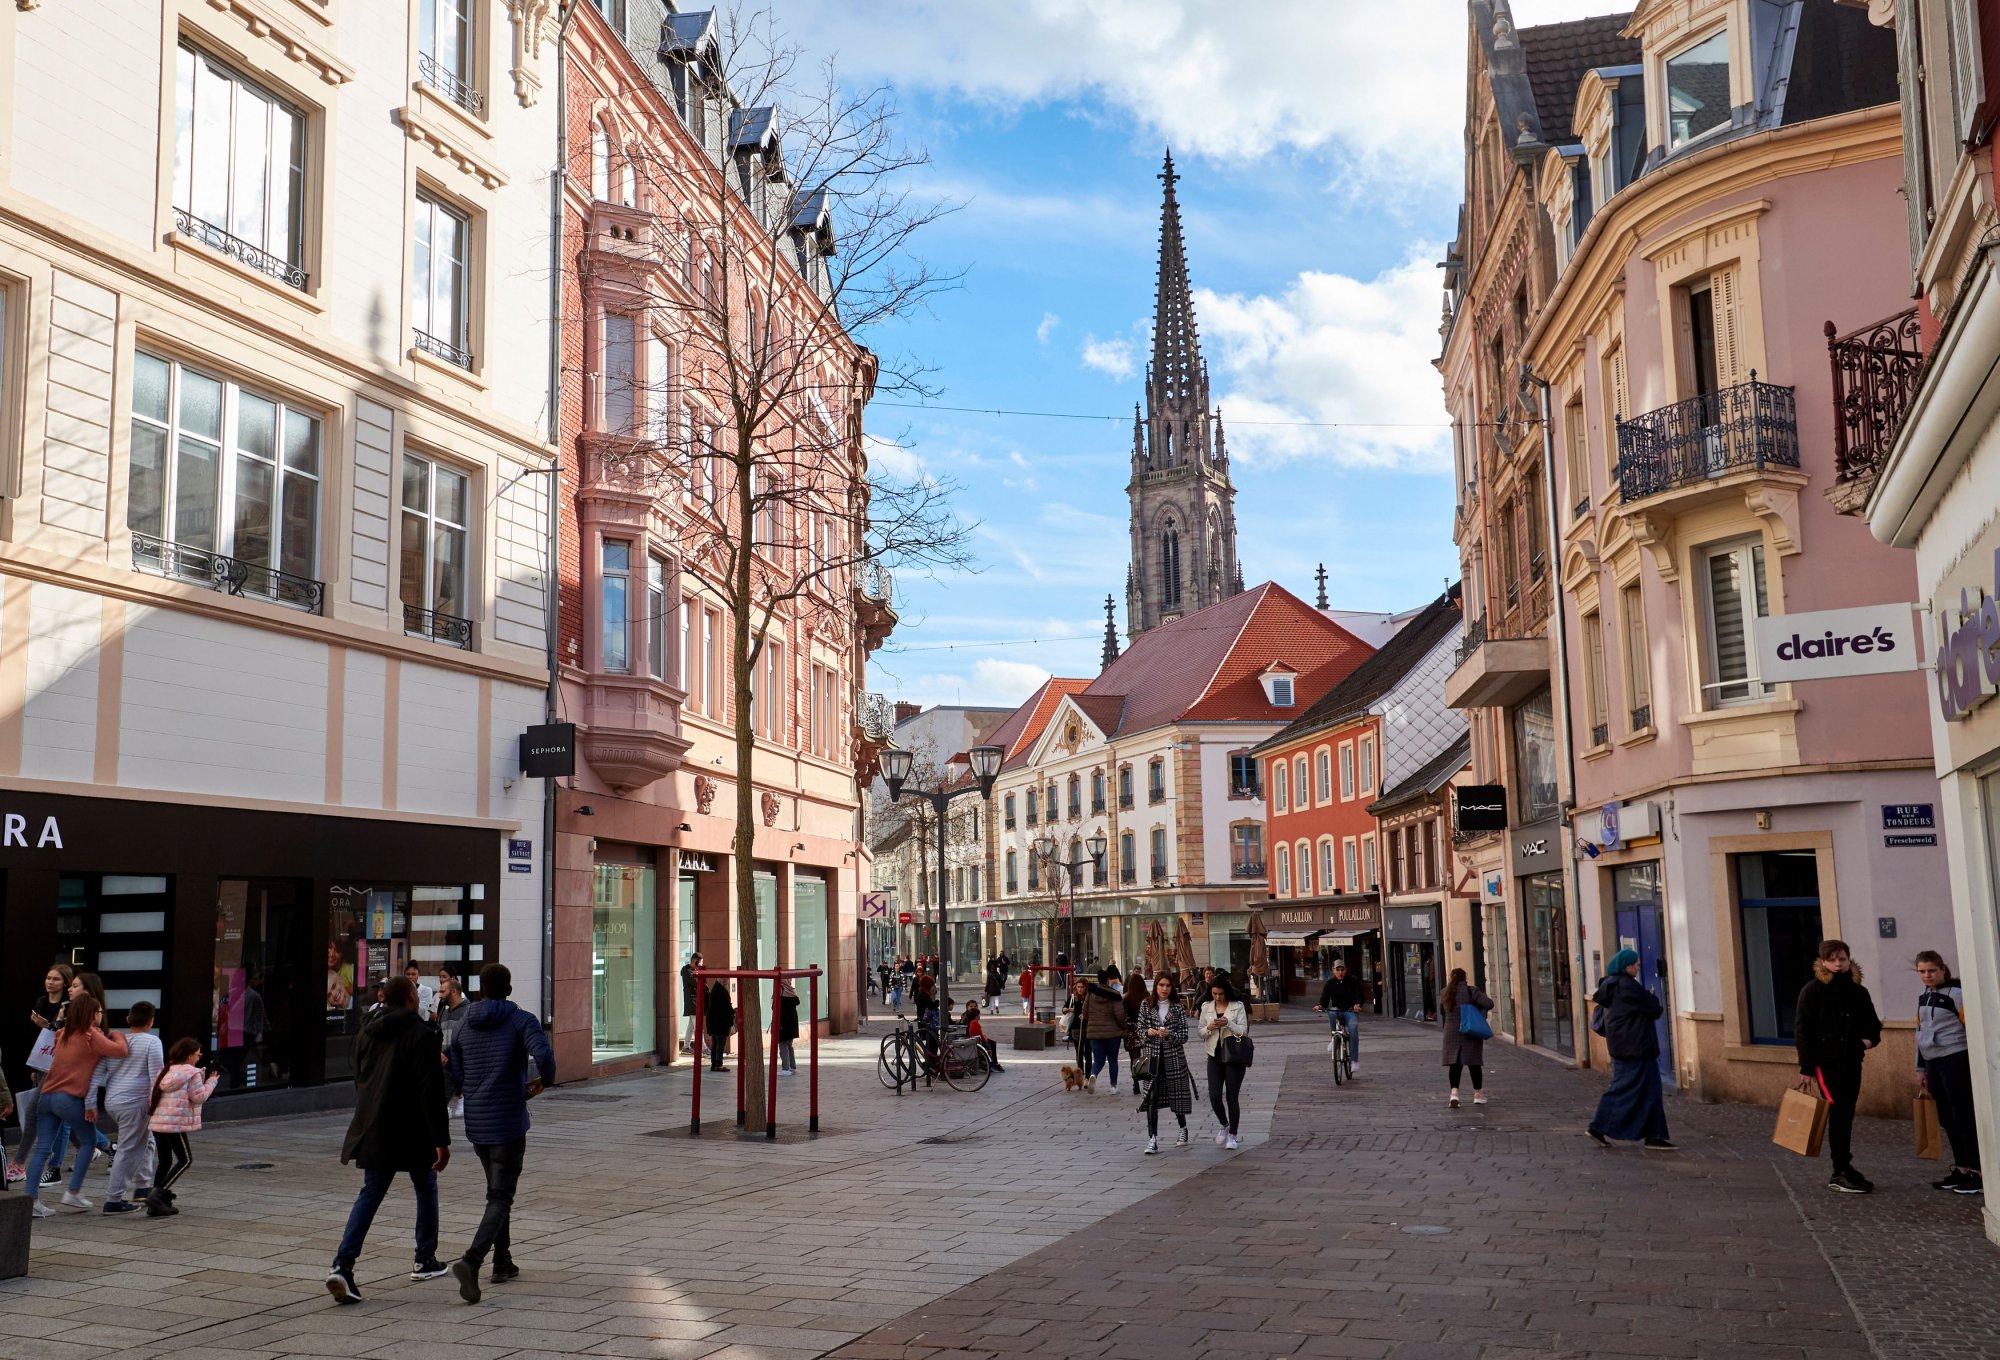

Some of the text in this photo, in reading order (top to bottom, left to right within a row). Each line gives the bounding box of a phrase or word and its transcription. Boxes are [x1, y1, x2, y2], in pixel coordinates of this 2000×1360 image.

[1776, 626, 1896, 661] claire's
[531, 746, 566, 755] SEPHORA
[1896, 806, 1919, 815] RUE
[1601, 813, 1617, 830] LCL
[1886, 818, 1932, 827] TONDEURS
[3, 813, 64, 849] RA
[679, 851, 710, 871] ZARA
[1281, 911, 1313, 923] POULAILLON
[1338, 908, 1372, 921] POULAILLON
